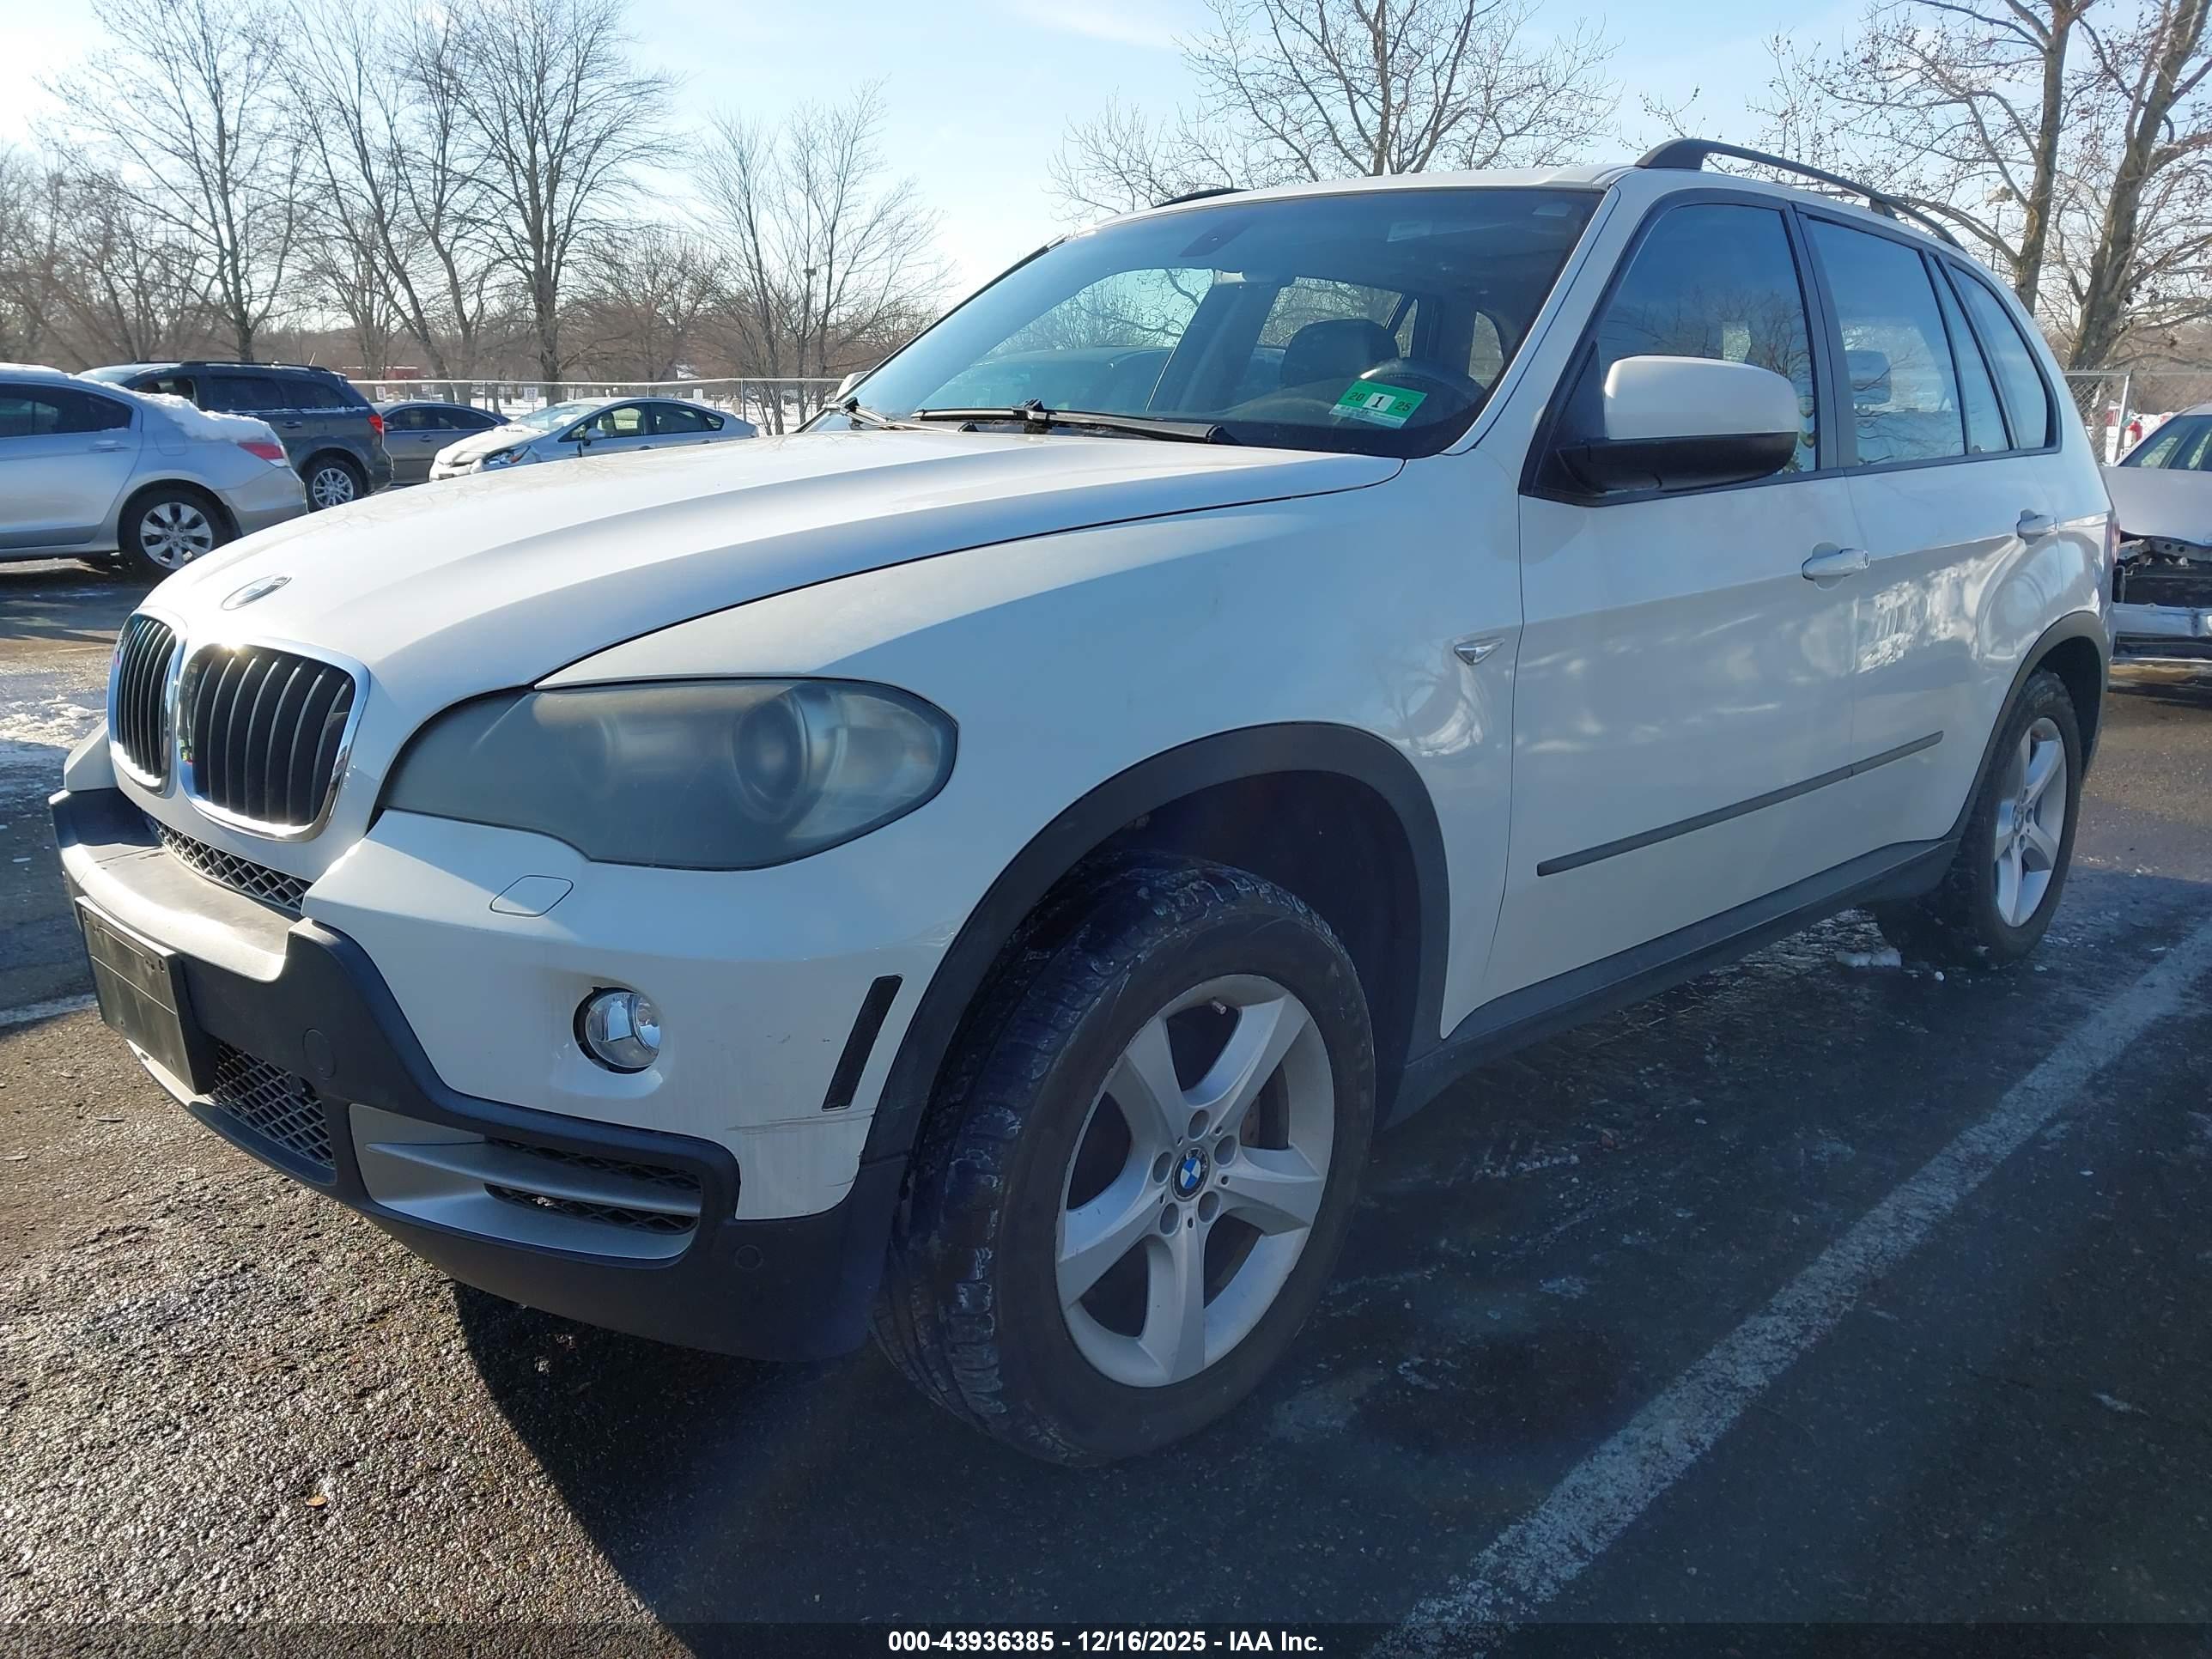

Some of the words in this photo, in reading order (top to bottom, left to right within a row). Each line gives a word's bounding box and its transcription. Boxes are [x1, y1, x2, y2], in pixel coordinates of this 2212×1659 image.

[1348, 392, 1365, 402] 20
[1371, 395, 1384, 408] 1
[1395, 401, 1412, 412] 25
